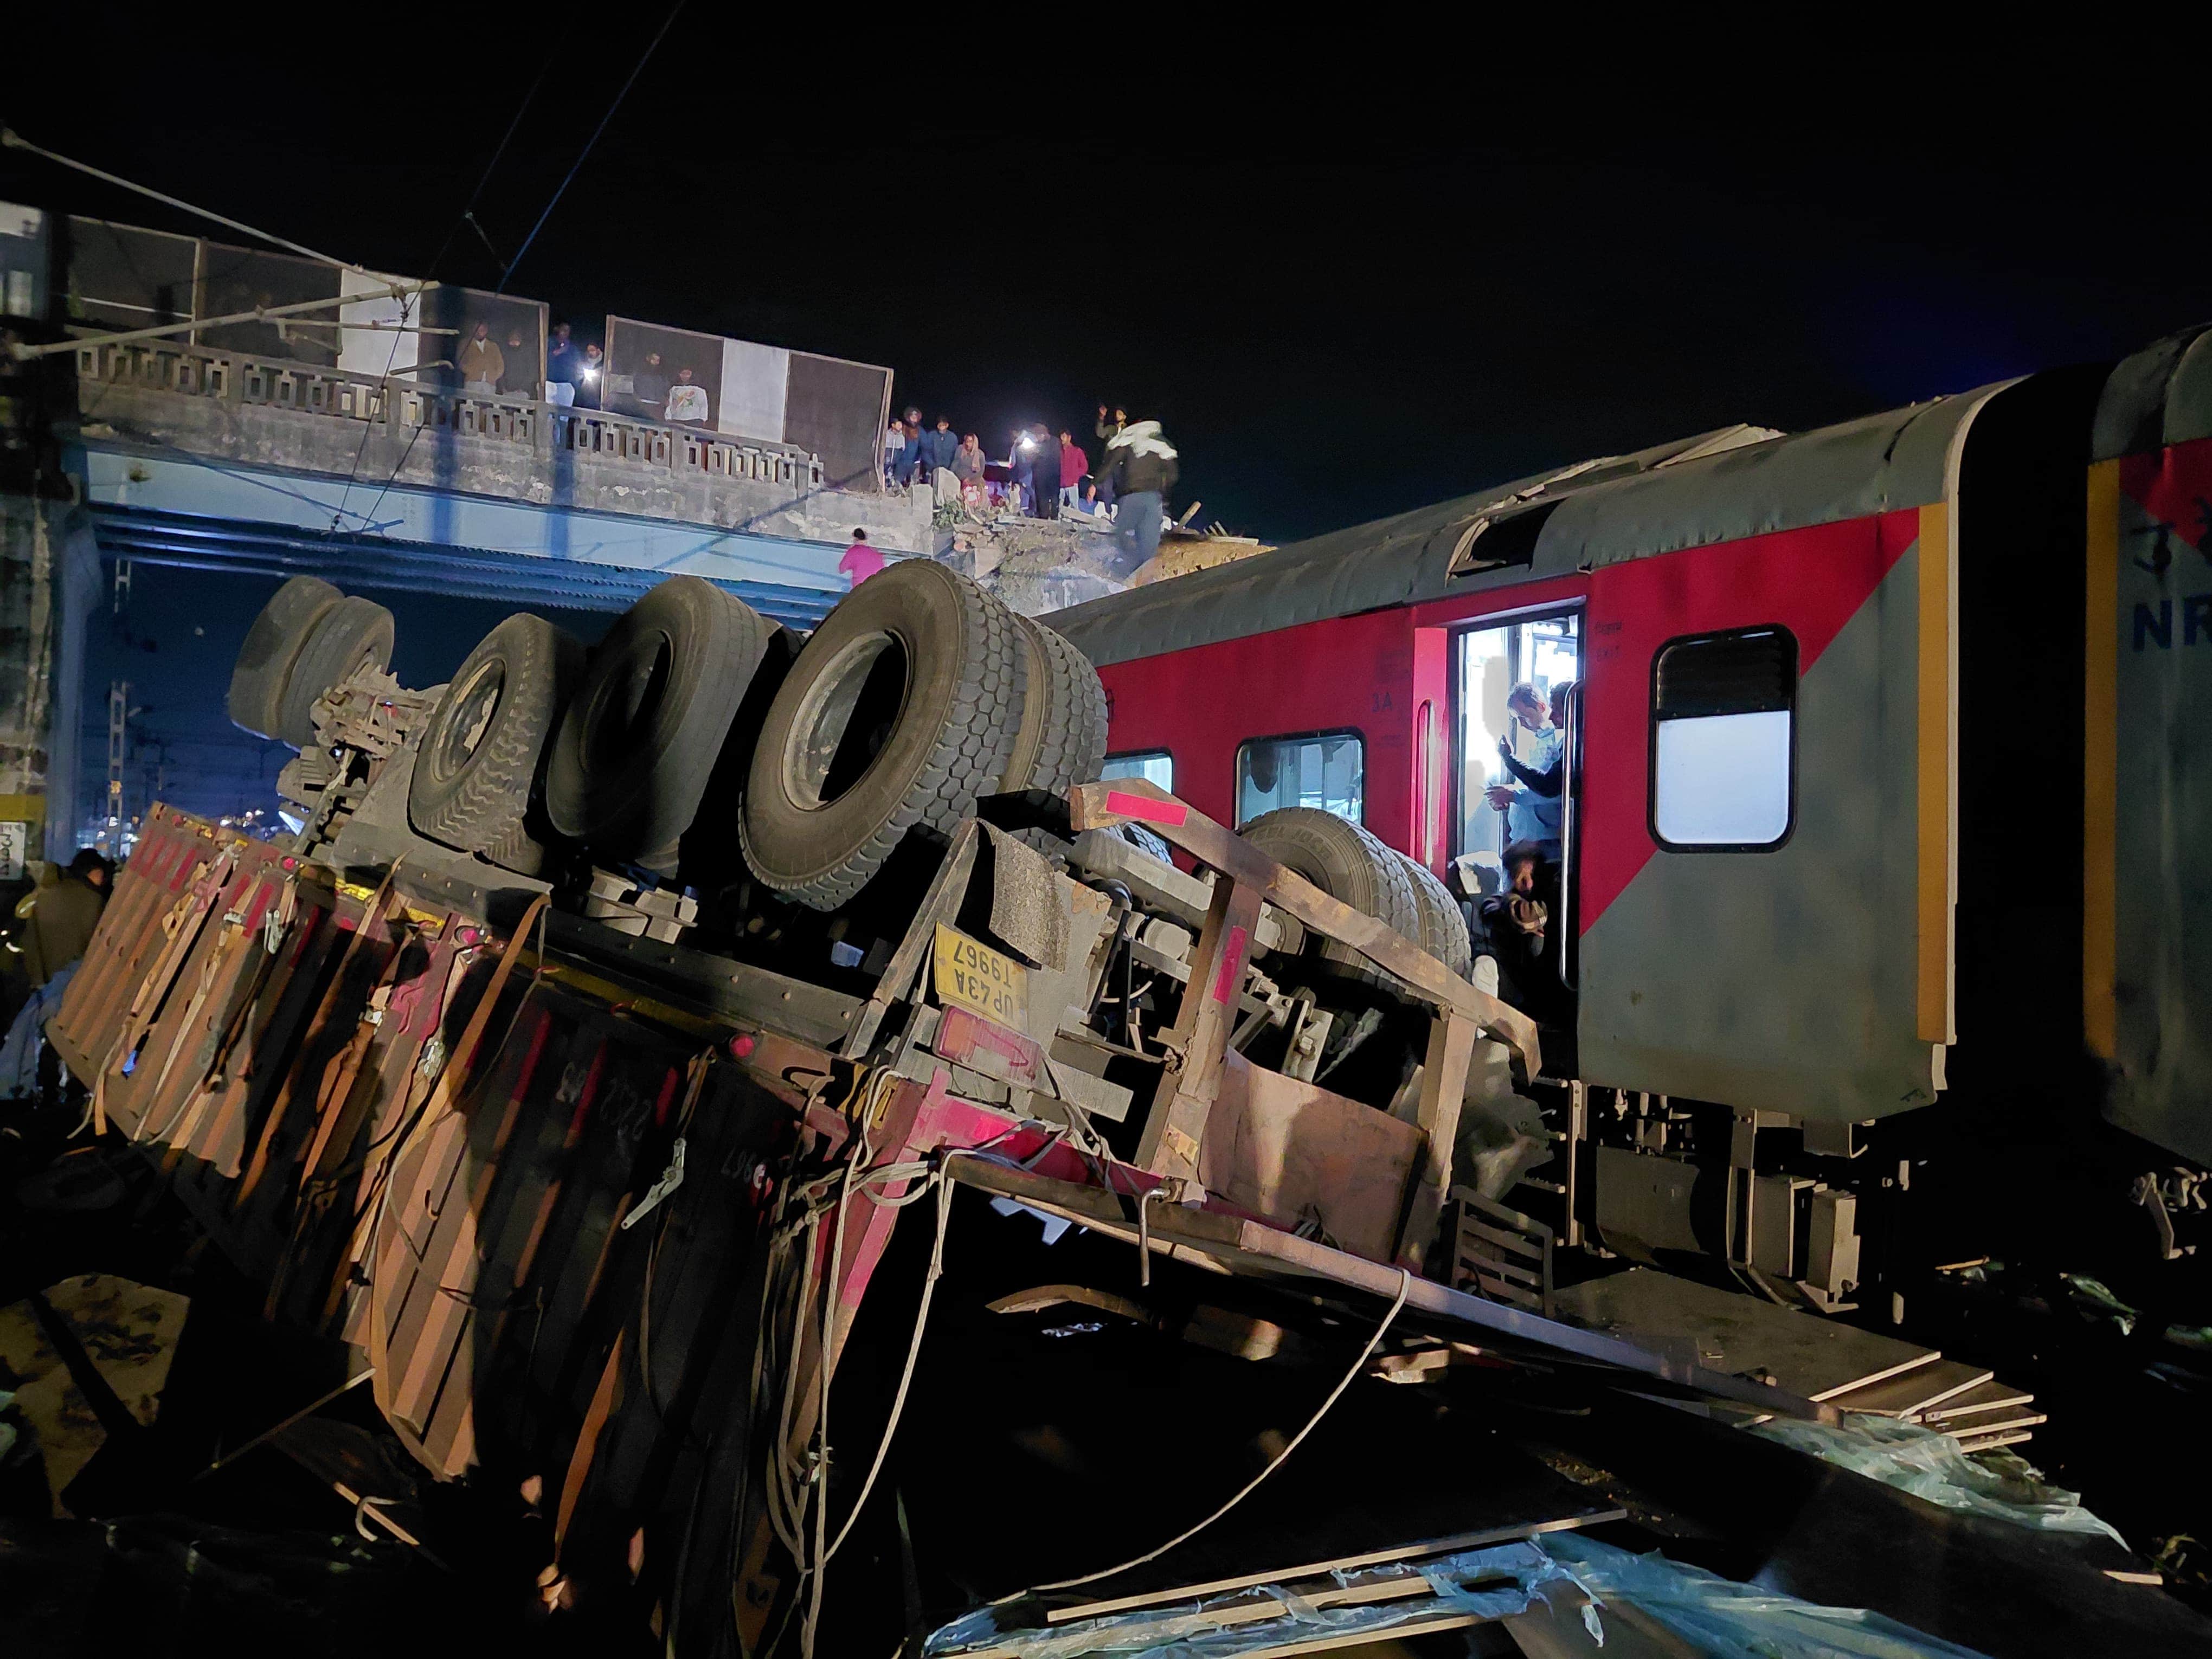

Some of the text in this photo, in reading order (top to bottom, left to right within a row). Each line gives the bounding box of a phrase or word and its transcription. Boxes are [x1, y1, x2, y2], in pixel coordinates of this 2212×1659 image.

[953, 940, 1012, 989] T9967
[954, 968, 1014, 1020] UP 43A
